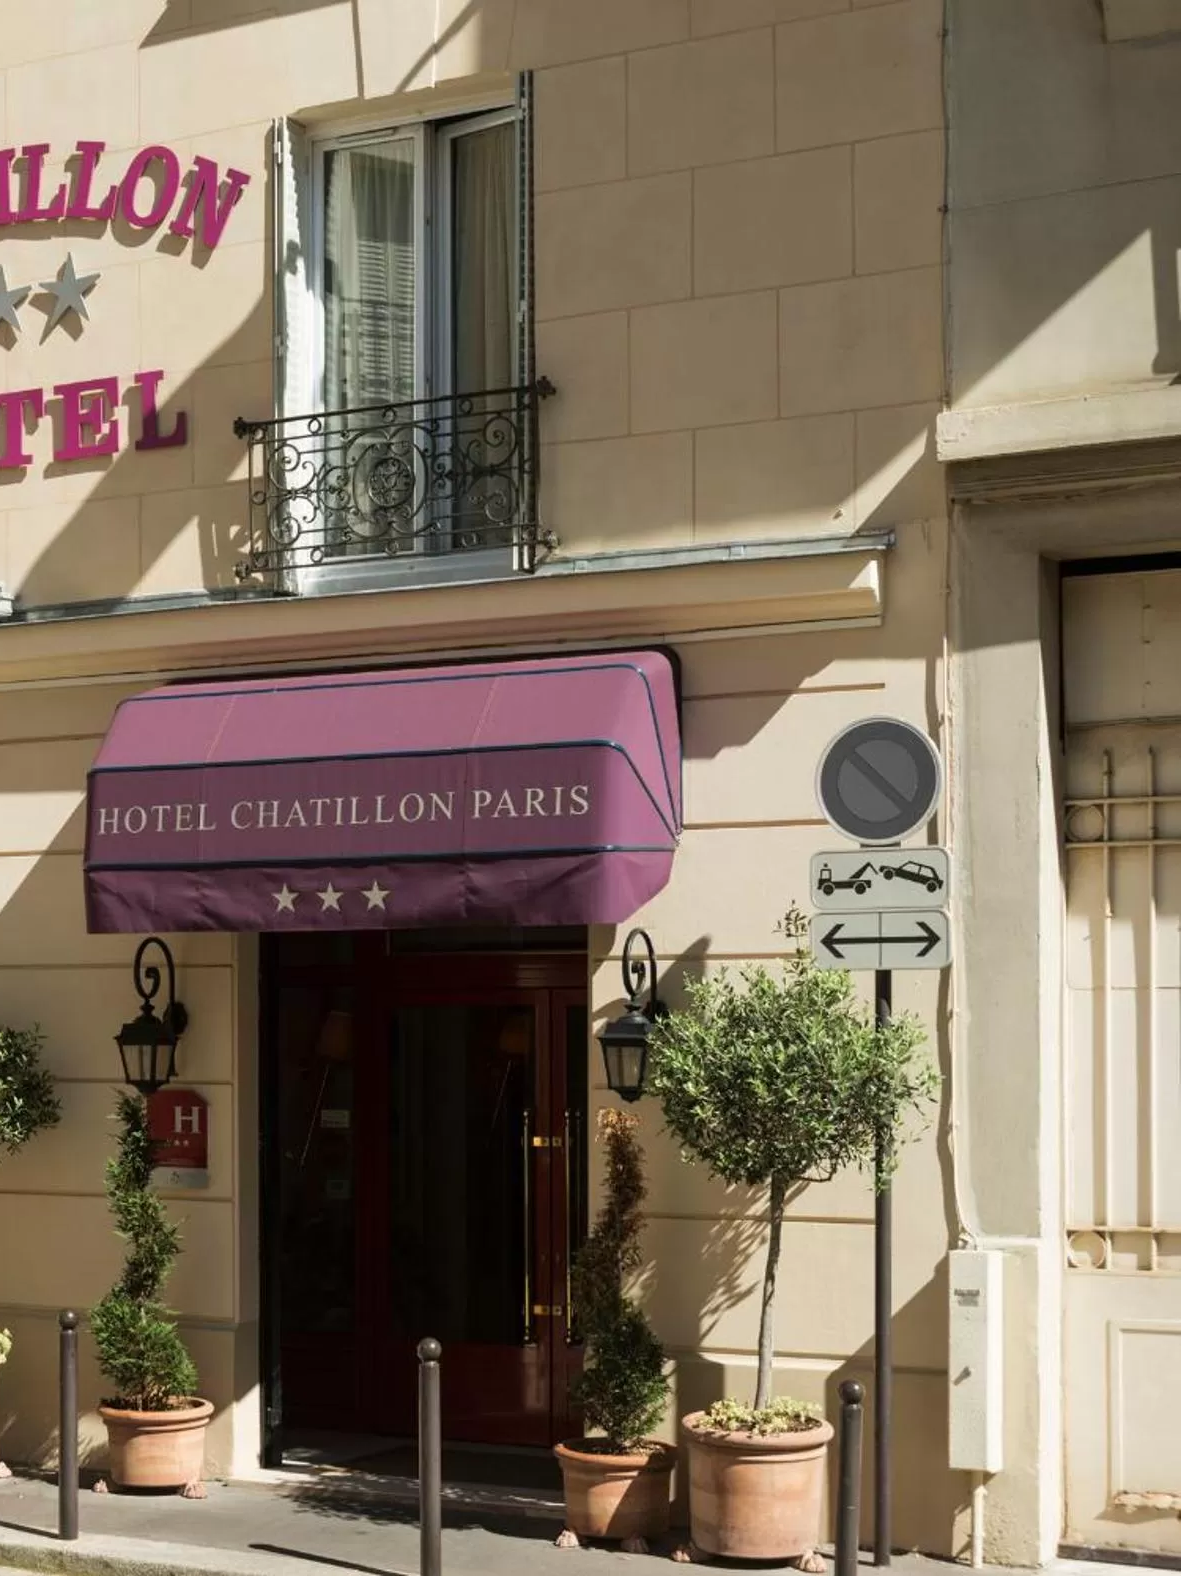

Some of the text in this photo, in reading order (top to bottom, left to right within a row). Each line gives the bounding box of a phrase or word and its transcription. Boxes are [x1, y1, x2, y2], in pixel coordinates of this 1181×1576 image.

[98, 785, 590, 835] HOTEL CHATILLON PARIS
[173, 1105, 201, 1133] H
